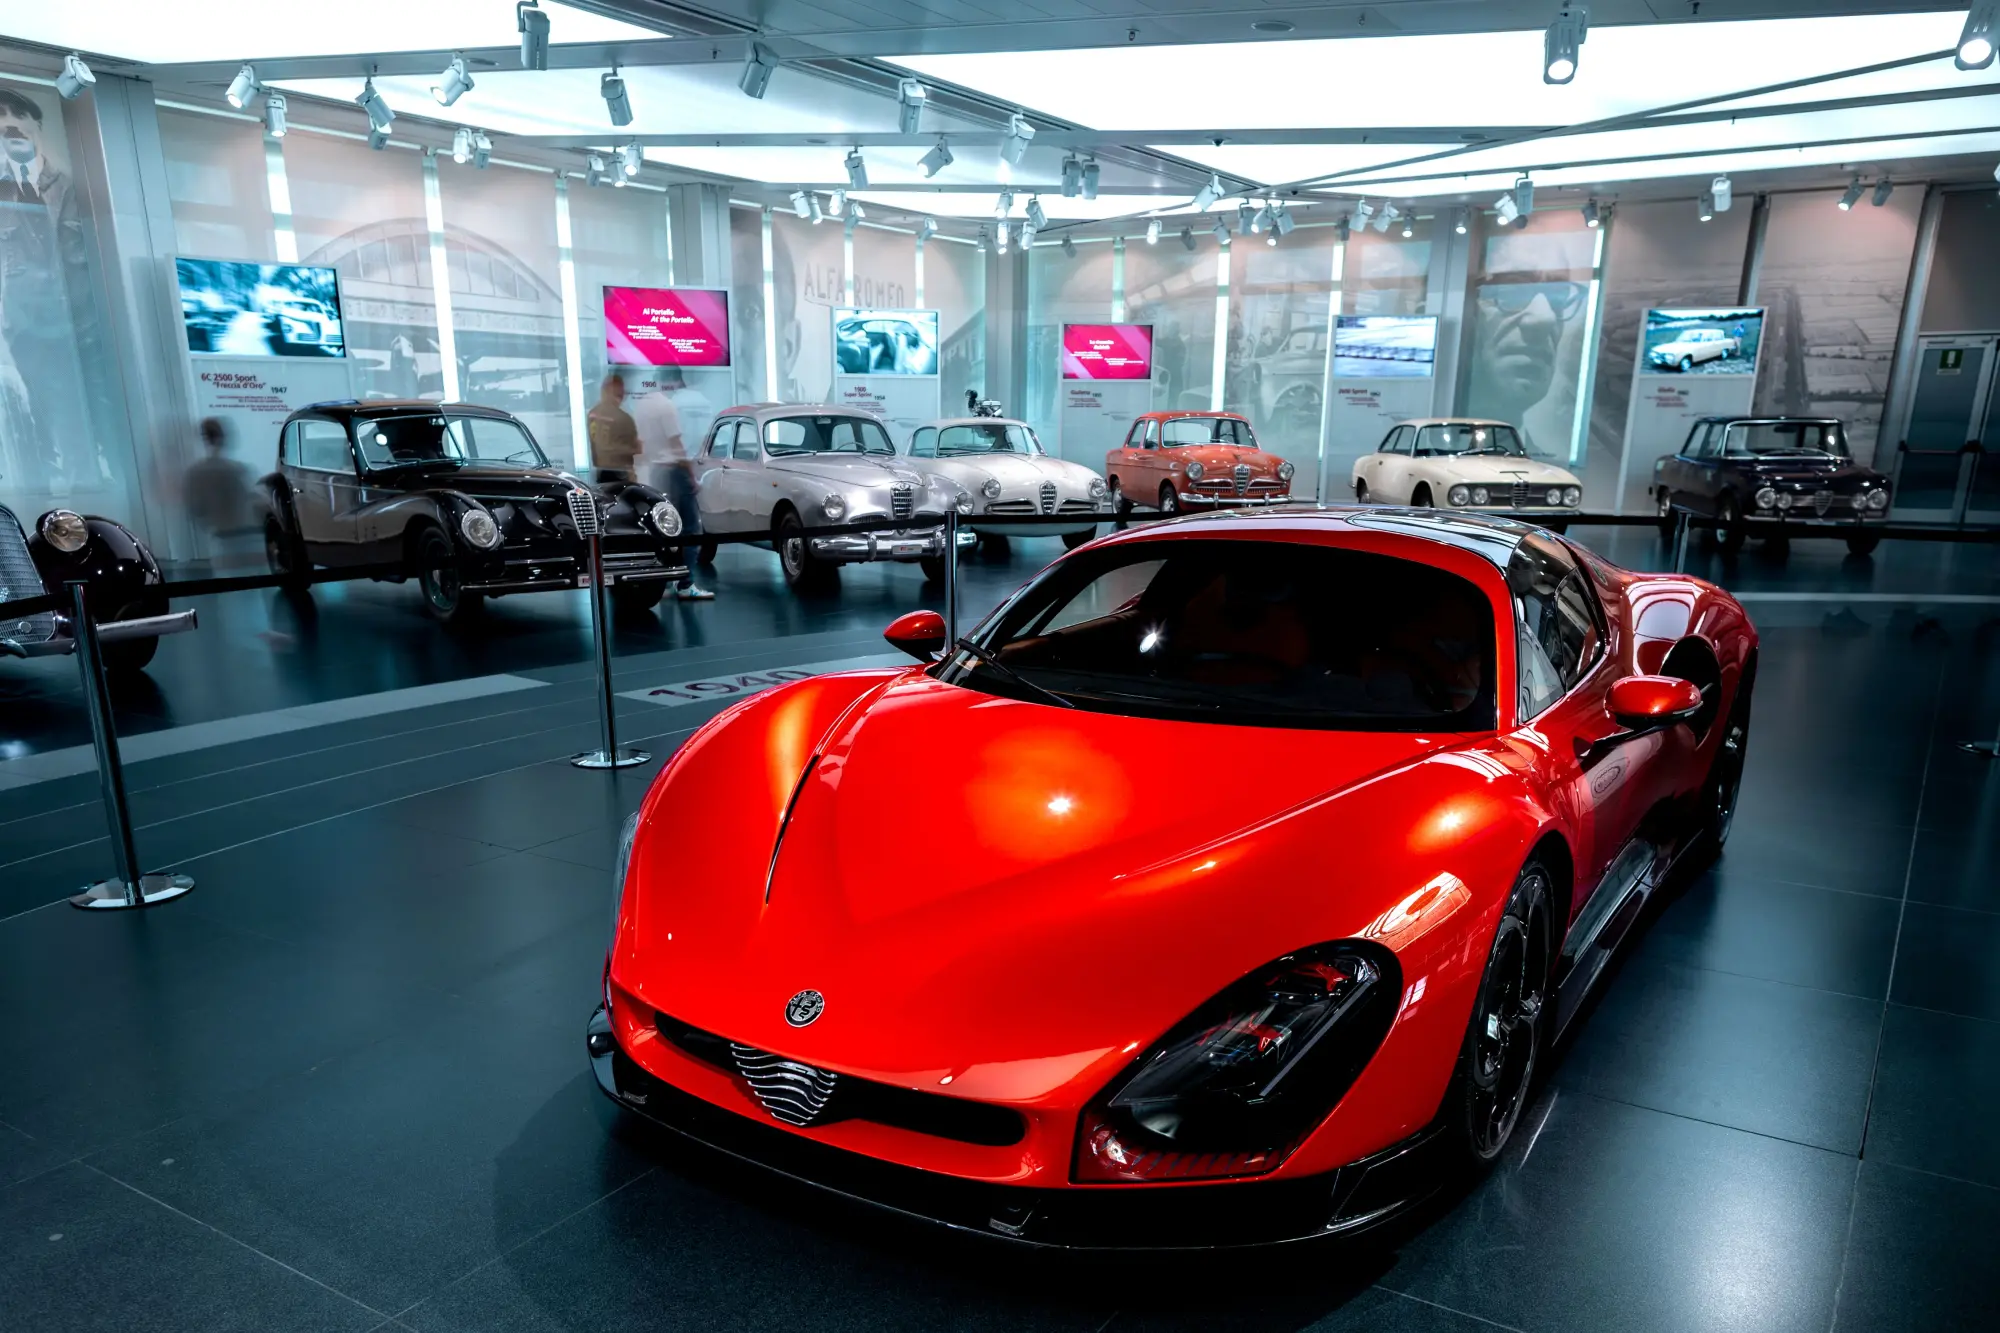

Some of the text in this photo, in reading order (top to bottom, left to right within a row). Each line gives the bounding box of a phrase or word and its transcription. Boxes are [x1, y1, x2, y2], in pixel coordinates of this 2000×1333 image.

[804, 262, 905, 308] ALFA ROMEO
[671, 316, 694, 324] Portello
[201, 373, 212, 382] 6C
[234, 374, 257, 383] Sport
[271, 386, 288, 394] 1947
